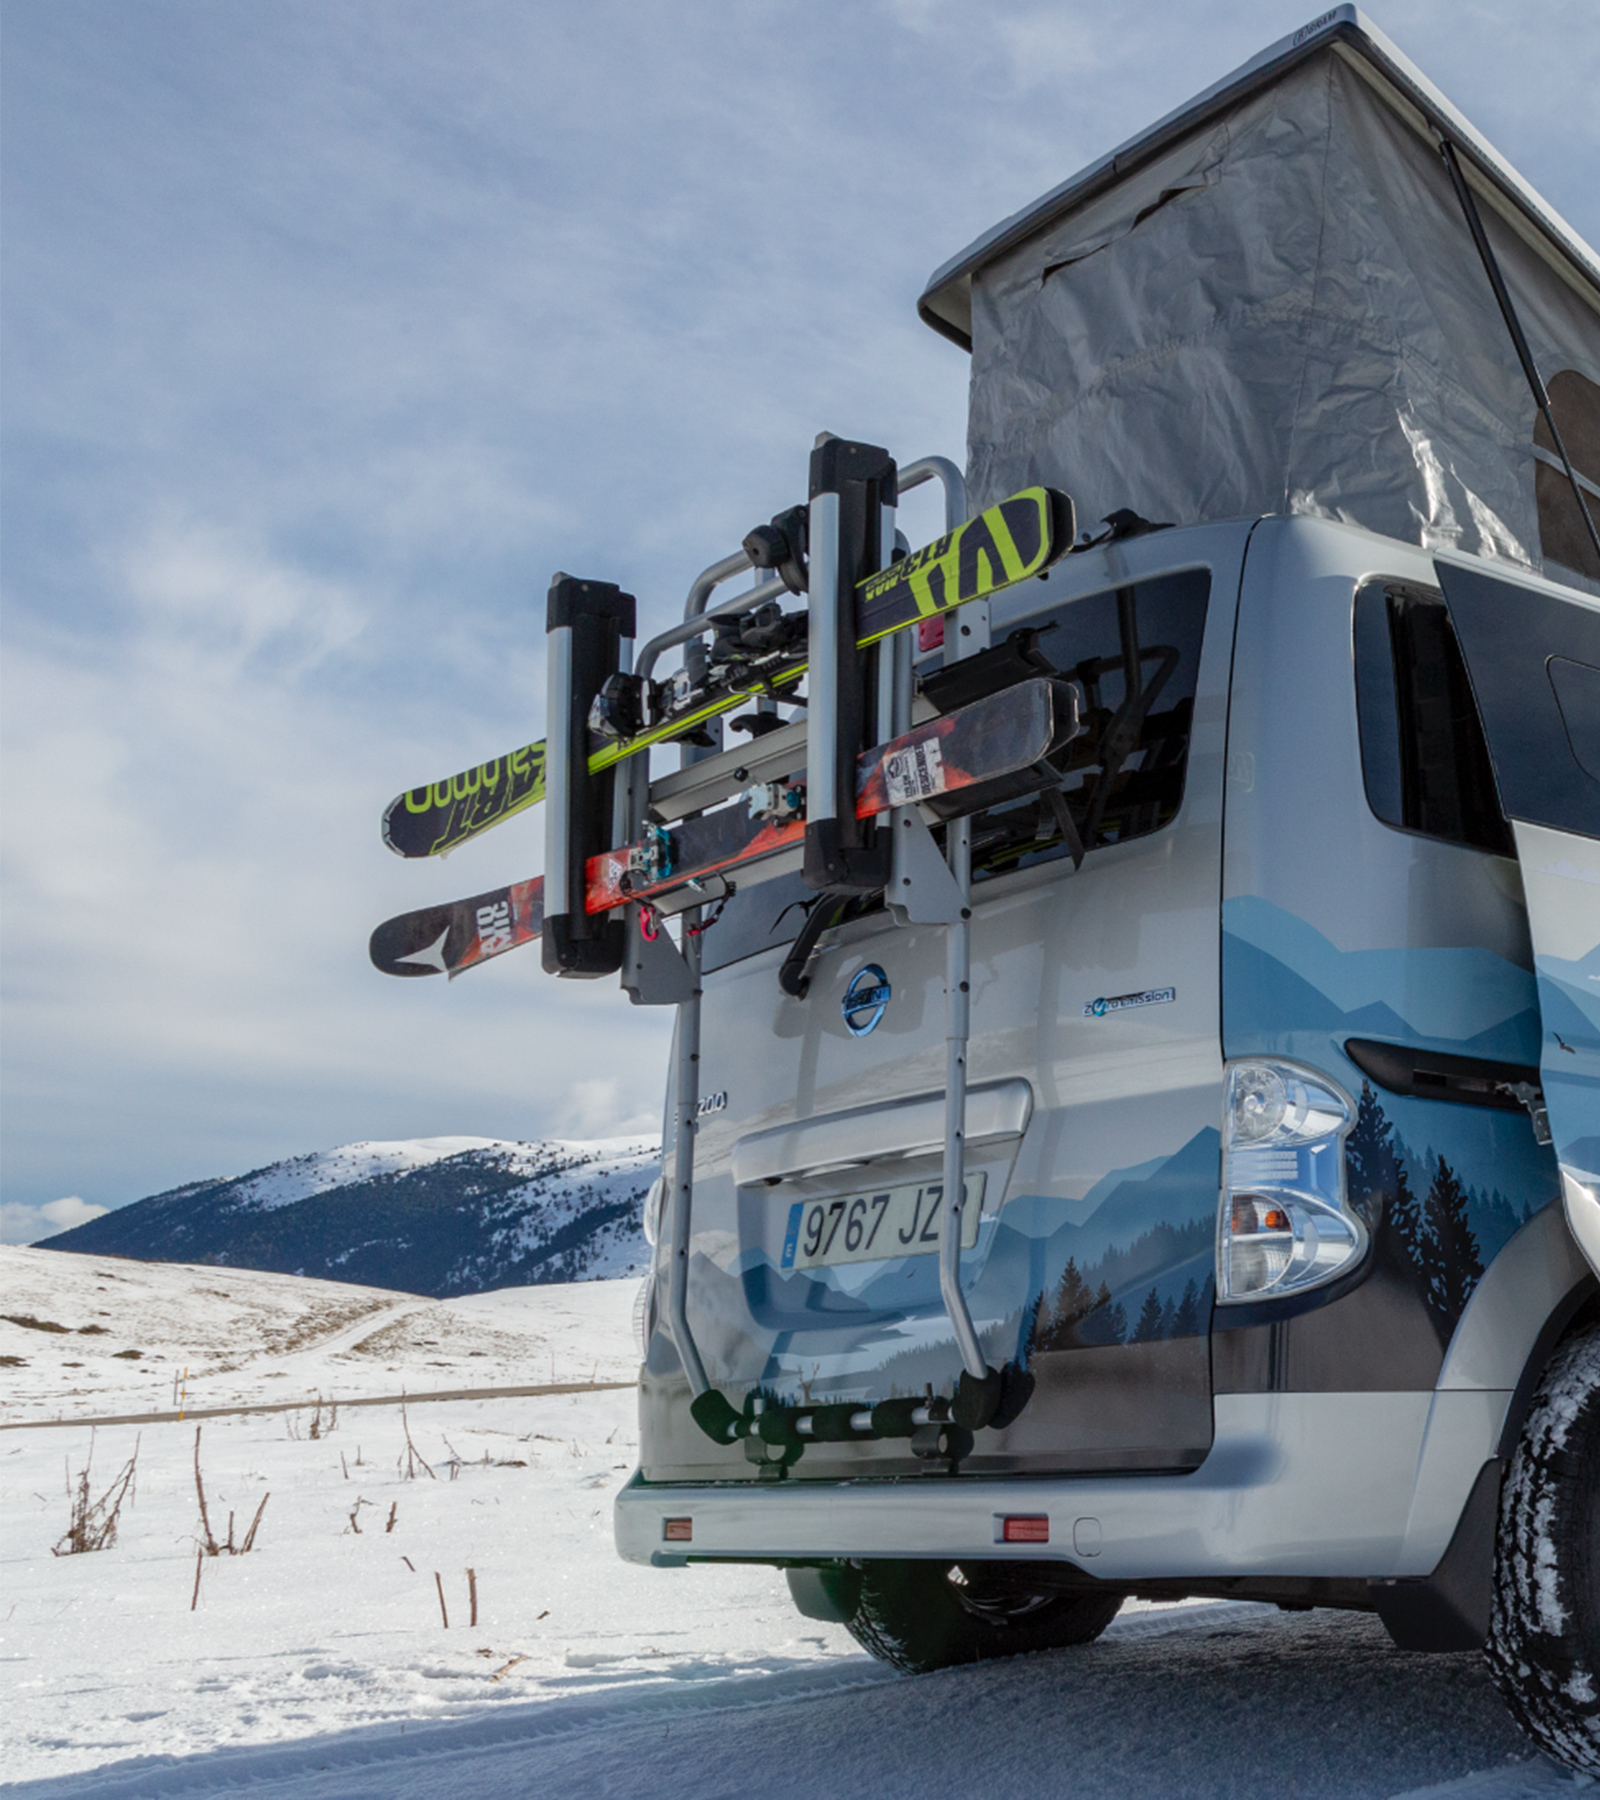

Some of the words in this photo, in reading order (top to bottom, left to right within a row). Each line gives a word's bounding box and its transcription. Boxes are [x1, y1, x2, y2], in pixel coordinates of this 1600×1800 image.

[697, 1091, 727, 1117] 200
[804, 1194, 891, 1258] 9767
[898, 1184, 968, 1245] JZ
